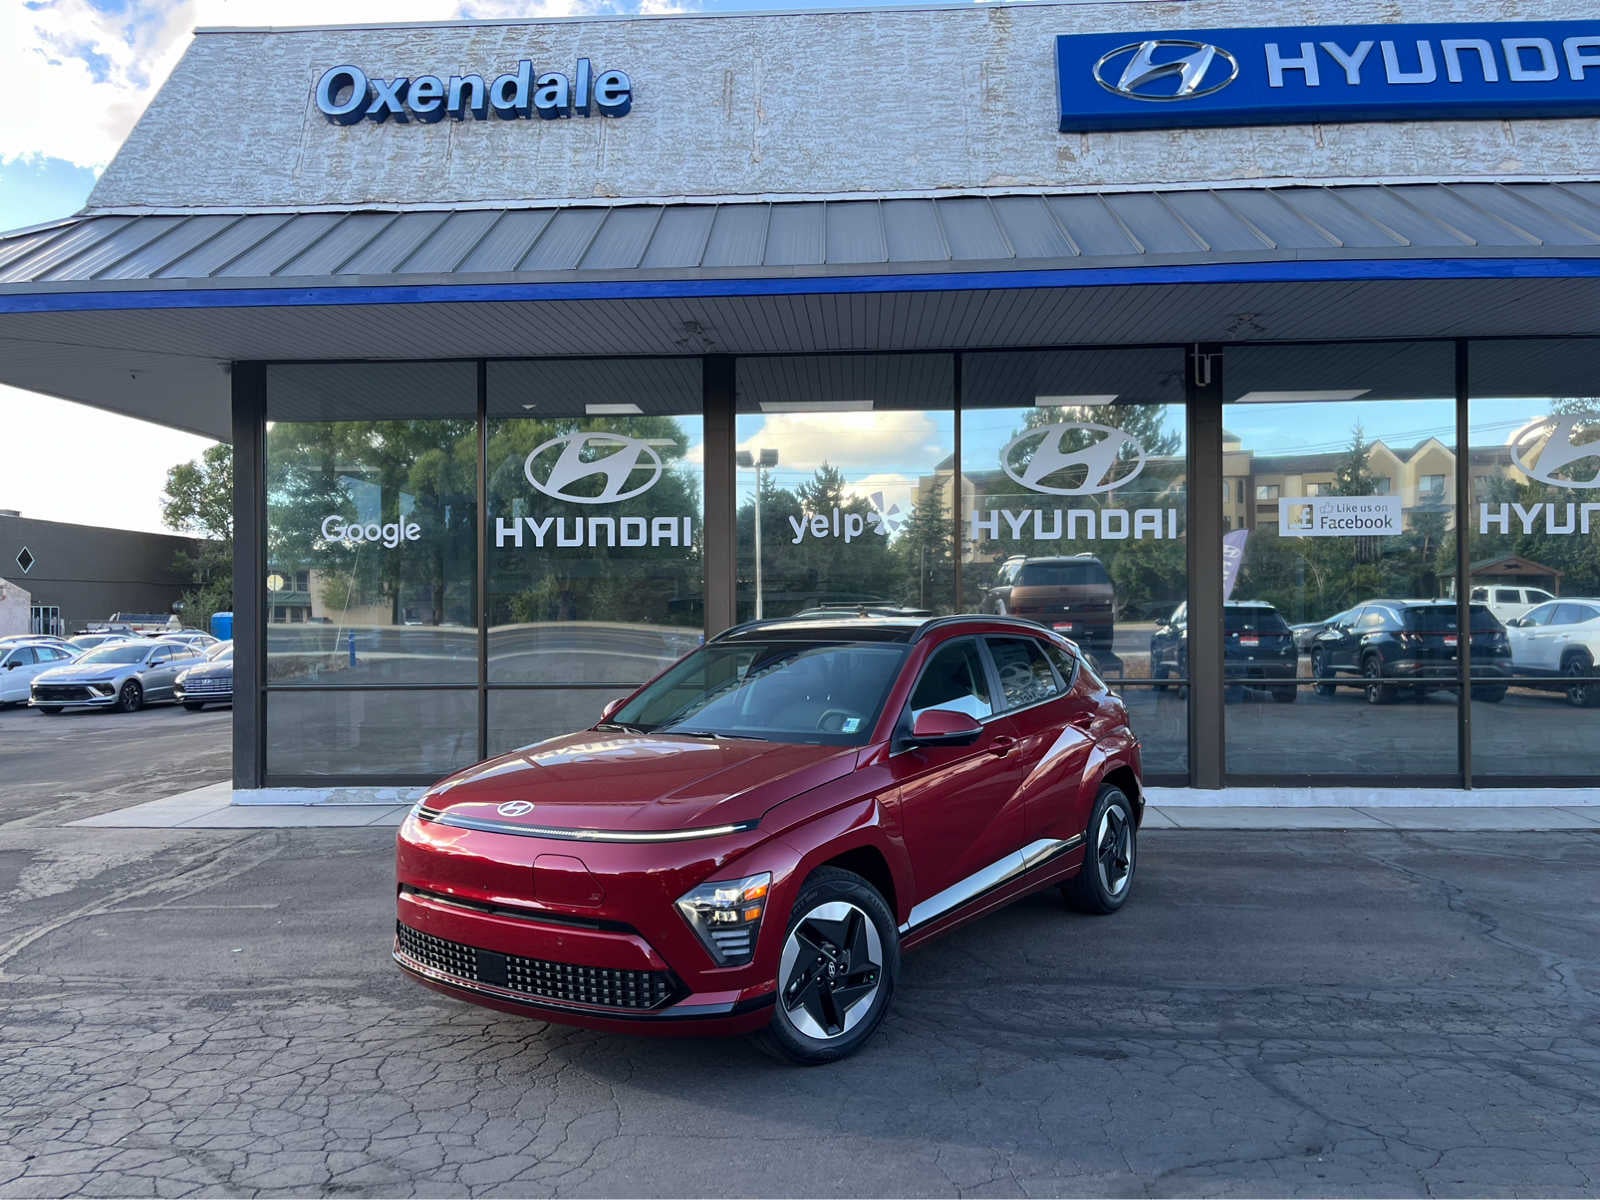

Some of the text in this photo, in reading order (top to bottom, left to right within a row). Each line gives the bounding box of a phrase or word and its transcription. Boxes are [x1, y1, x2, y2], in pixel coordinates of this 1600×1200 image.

[315, 57, 632, 124] Oxendale
[971, 508, 1177, 541] HYUNDAI
[1319, 514, 1393, 530] Facebook
[1336, 503, 1388, 513] Like us on
[320, 514, 422, 549] Google
[495, 516, 692, 548] HYUNDAI
[788, 507, 864, 544] yelp
